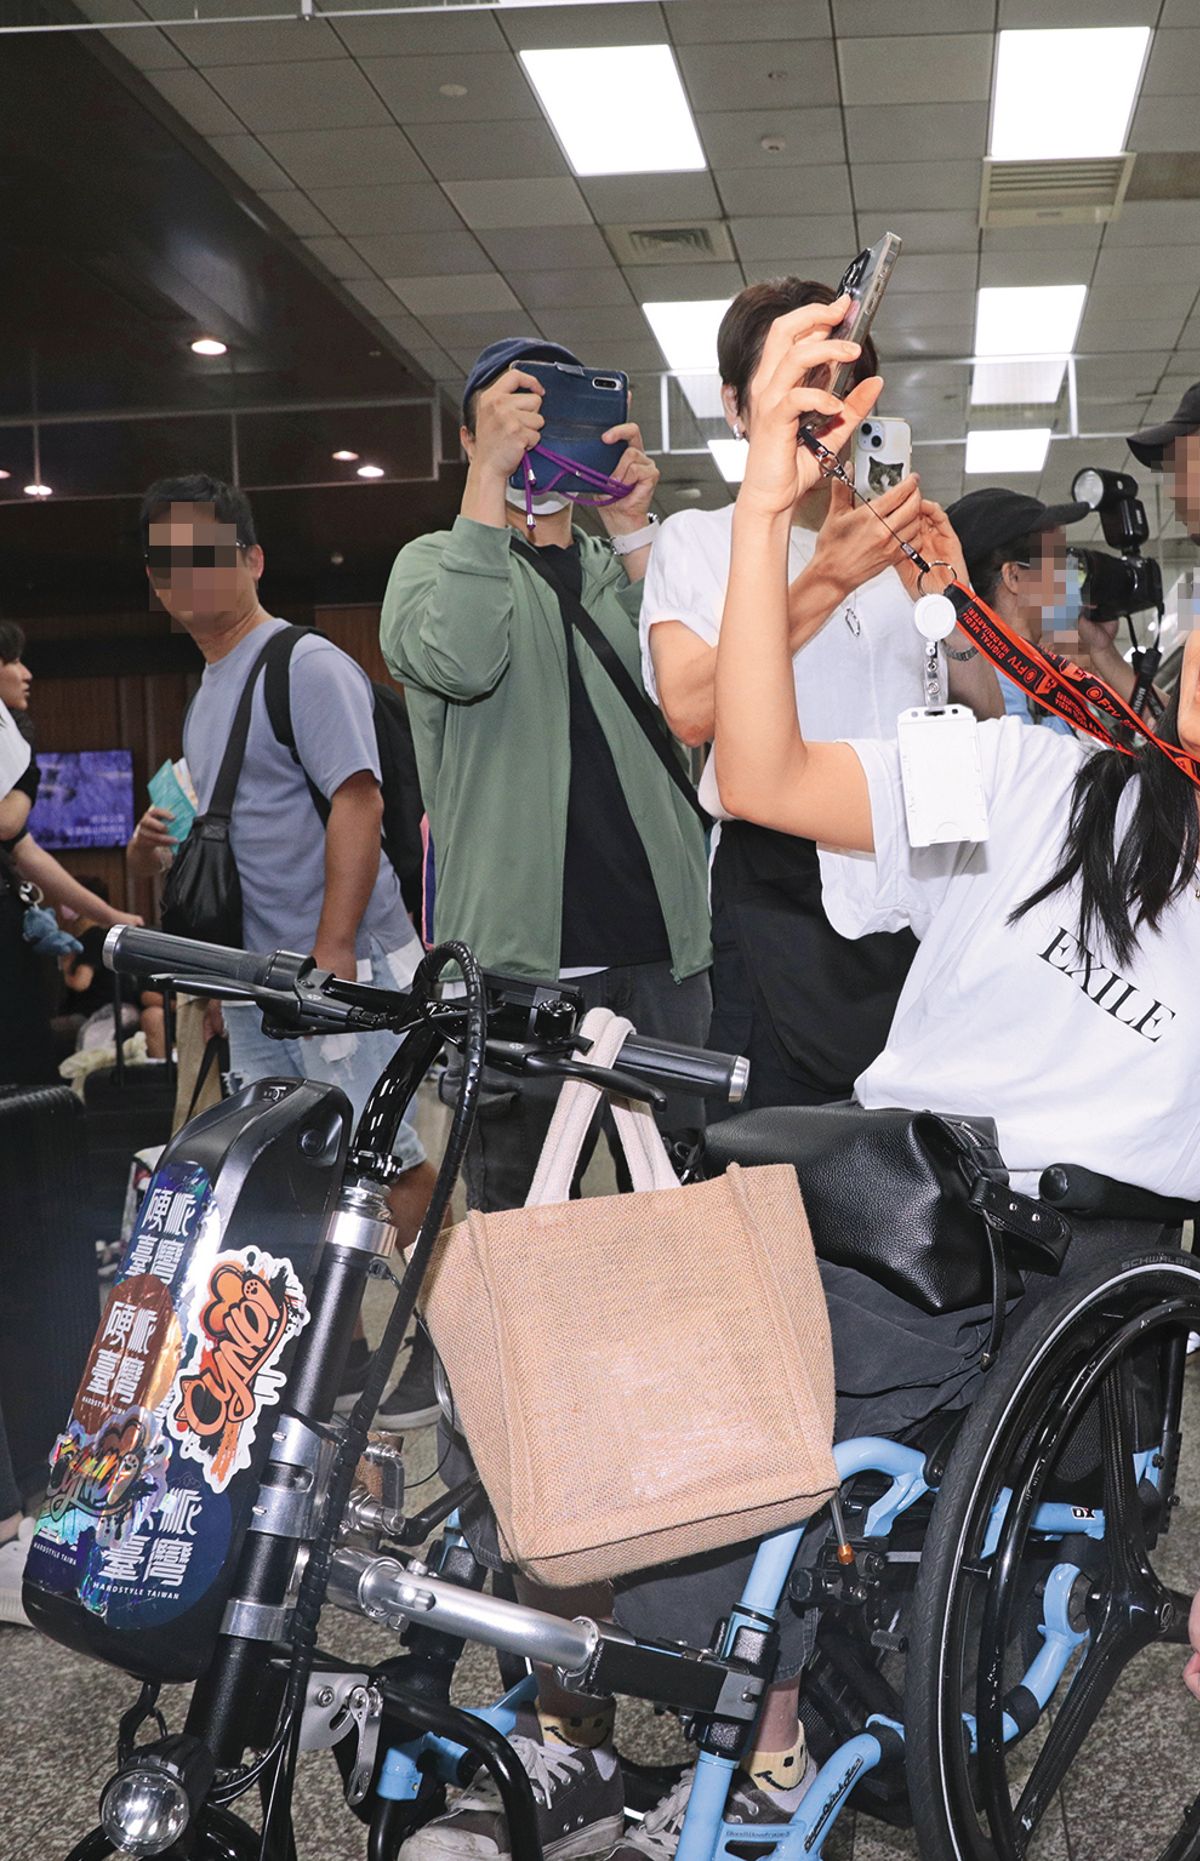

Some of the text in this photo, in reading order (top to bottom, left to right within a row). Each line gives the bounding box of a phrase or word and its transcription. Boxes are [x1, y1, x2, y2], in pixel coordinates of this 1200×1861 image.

[1008, 656, 1028, 675] FTV
[1036, 925, 1176, 1043] EXILE
[93, 1581, 180, 1600] HARDSTYLE TAIWAN
